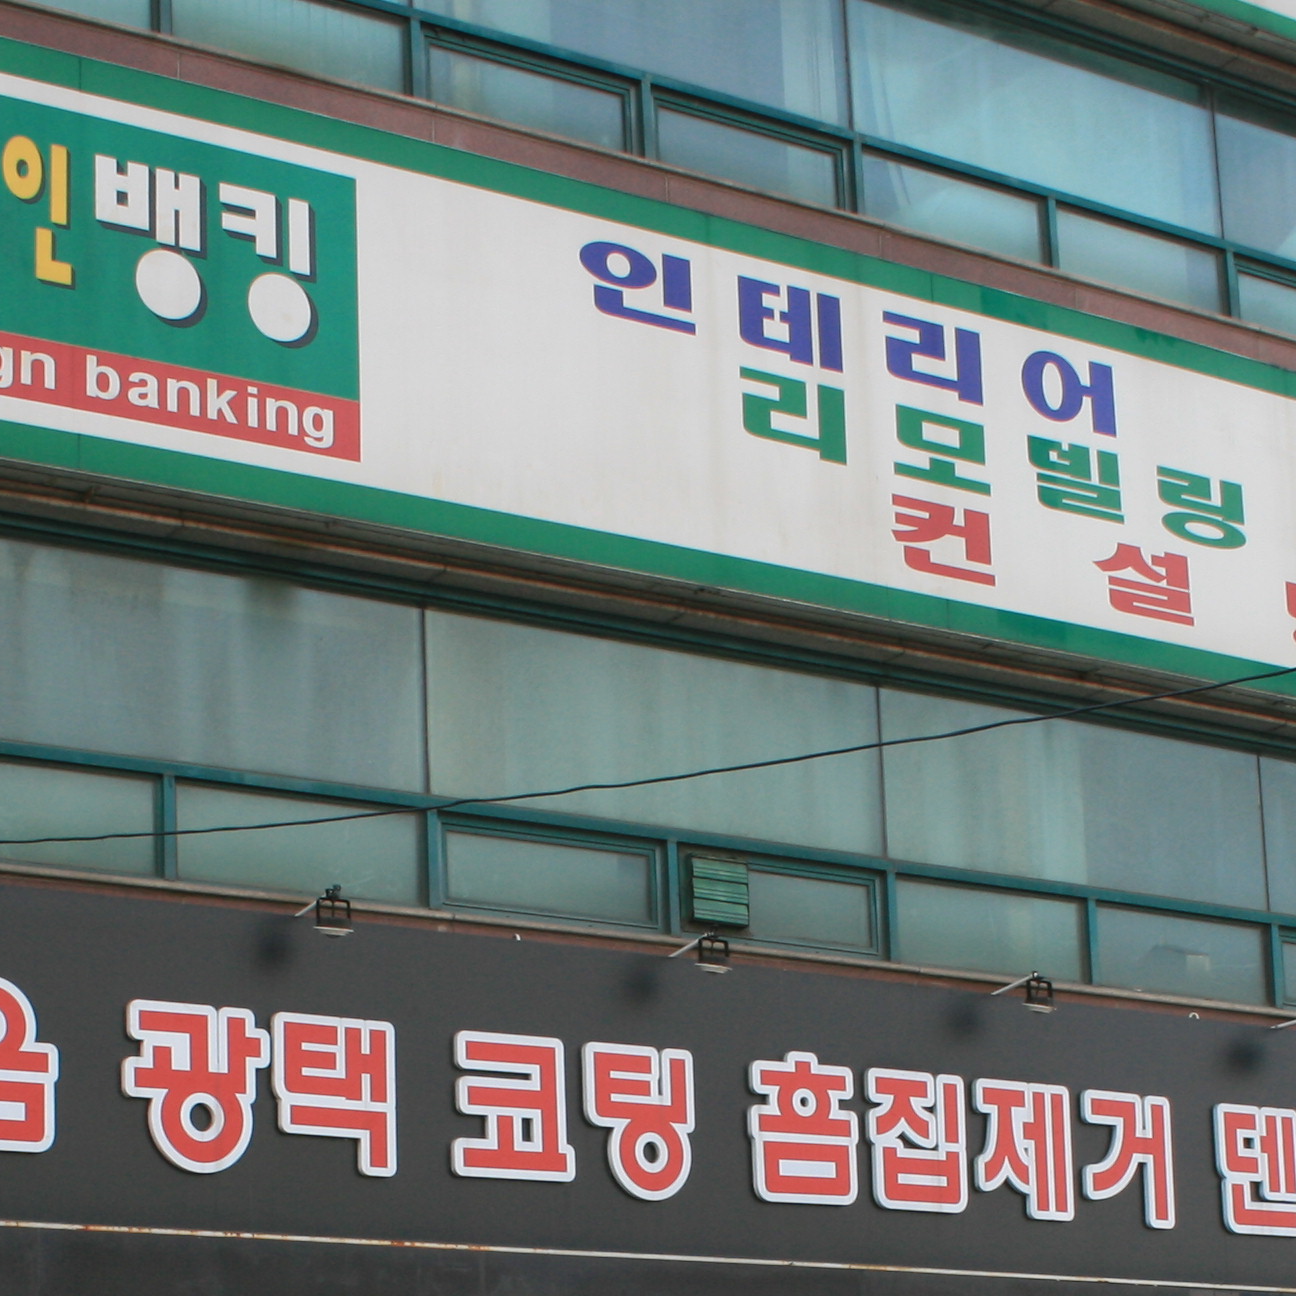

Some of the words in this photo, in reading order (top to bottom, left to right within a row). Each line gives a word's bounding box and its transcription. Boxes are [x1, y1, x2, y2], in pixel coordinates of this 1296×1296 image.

[85, 353, 336, 449] banking
[578, 240, 1118, 439] 인테리어
[739, 365, 1247, 550] 리모델링
[121, 998, 398, 1178] 광택
[450, 1029, 696, 1202] 코팅
[747, 1050, 1176, 1231] 흠집제거
